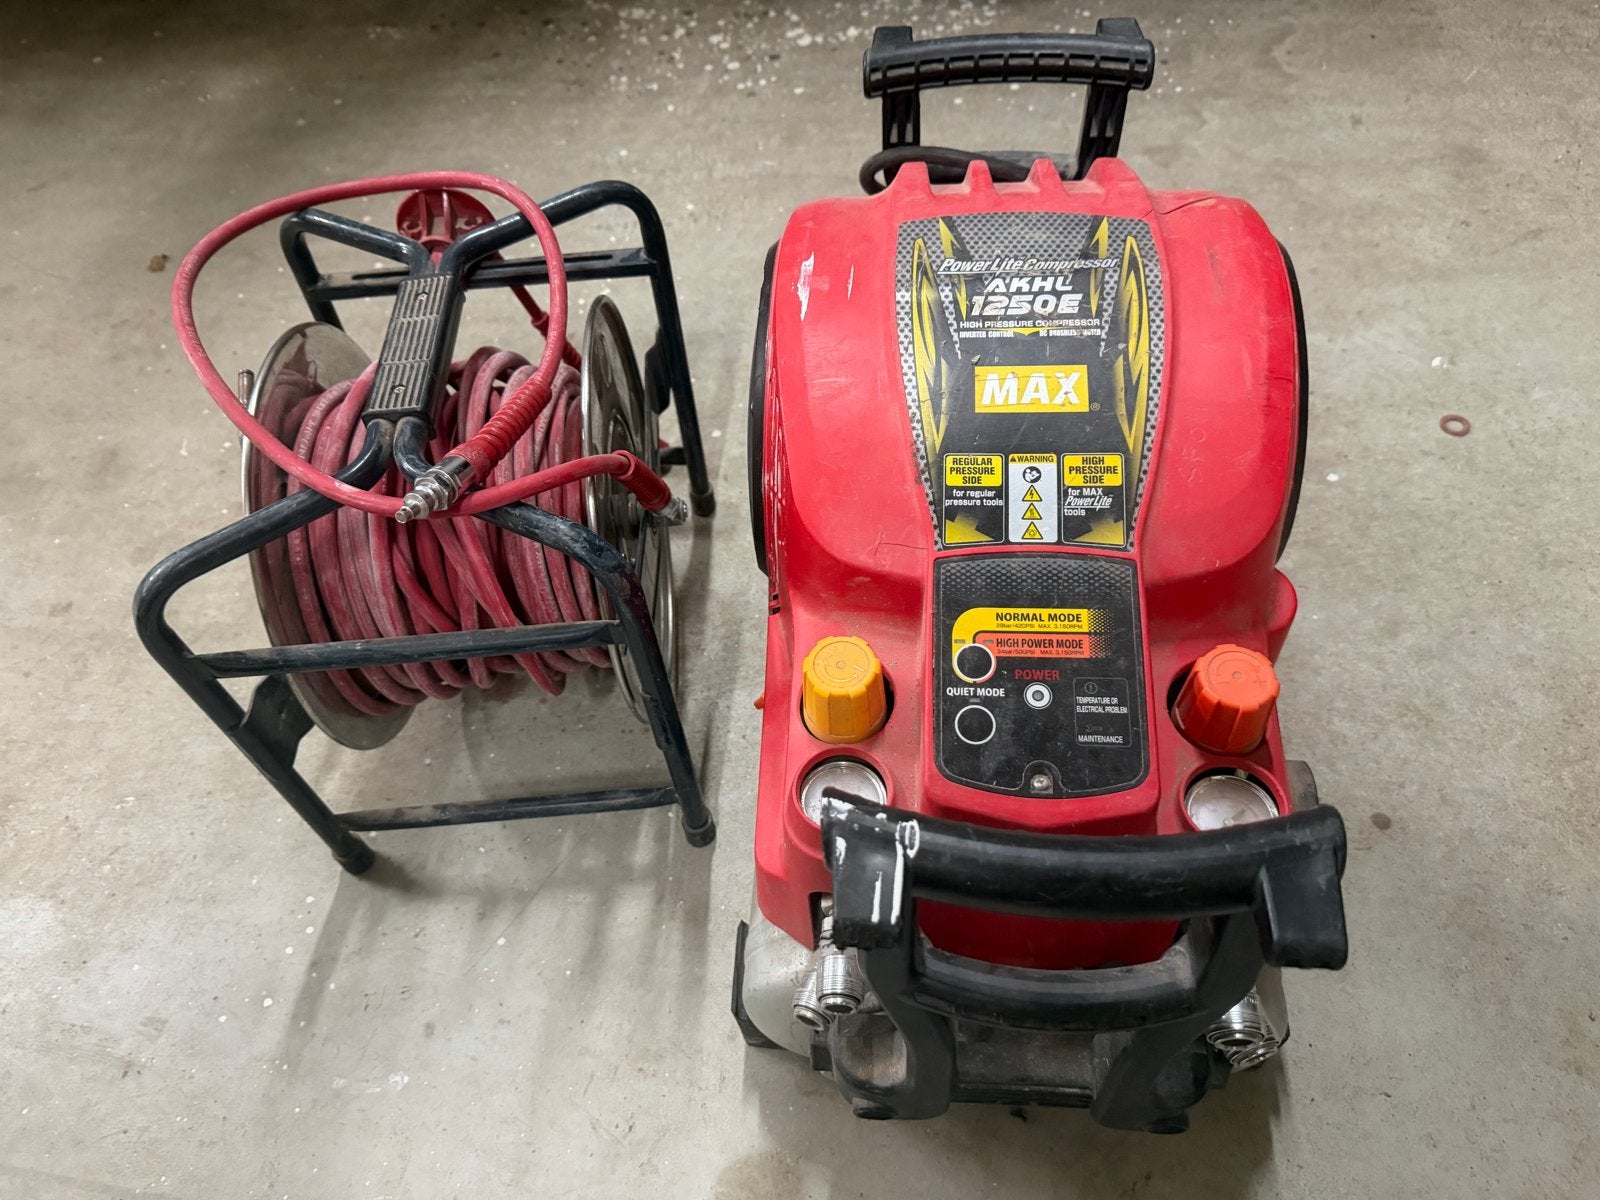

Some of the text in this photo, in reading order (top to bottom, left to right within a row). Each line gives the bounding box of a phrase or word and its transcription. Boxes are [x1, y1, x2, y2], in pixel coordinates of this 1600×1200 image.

[984, 277, 1073, 293] AKHL
[971, 294, 1084, 316] 1250E
[985, 320, 1033, 328] PRESSURE
[981, 372, 1081, 405] MAX
[952, 457, 993, 466] REGULAR
[1017, 455, 1054, 463] WARNING
[1082, 456, 1105, 465] HIGH
[949, 466, 995, 475] PRESSURE
[1069, 465, 1119, 475] PRESSURE
[962, 476, 982, 484] SIDE
[1082, 475, 1105, 484] SIDE
[952, 489, 996, 498] for regular
[1068, 487, 1103, 496] for MAX
[983, 498, 1003, 506] tools
[1064, 496, 1113, 508] PowerLite
[1064, 508, 1086, 516] tools
[996, 612, 1082, 623] NORMAL MODE
[996, 638, 1083, 649] HIGH POWER MODE
[1015, 669, 1061, 681] POWER
[946, 686, 1006, 697] QUIET MODE
[1076, 696, 1110, 704] TEMPERATURE
[1076, 705, 1104, 713] ELECTRICAL
[1078, 734, 1123, 743] MAINTENANCE
